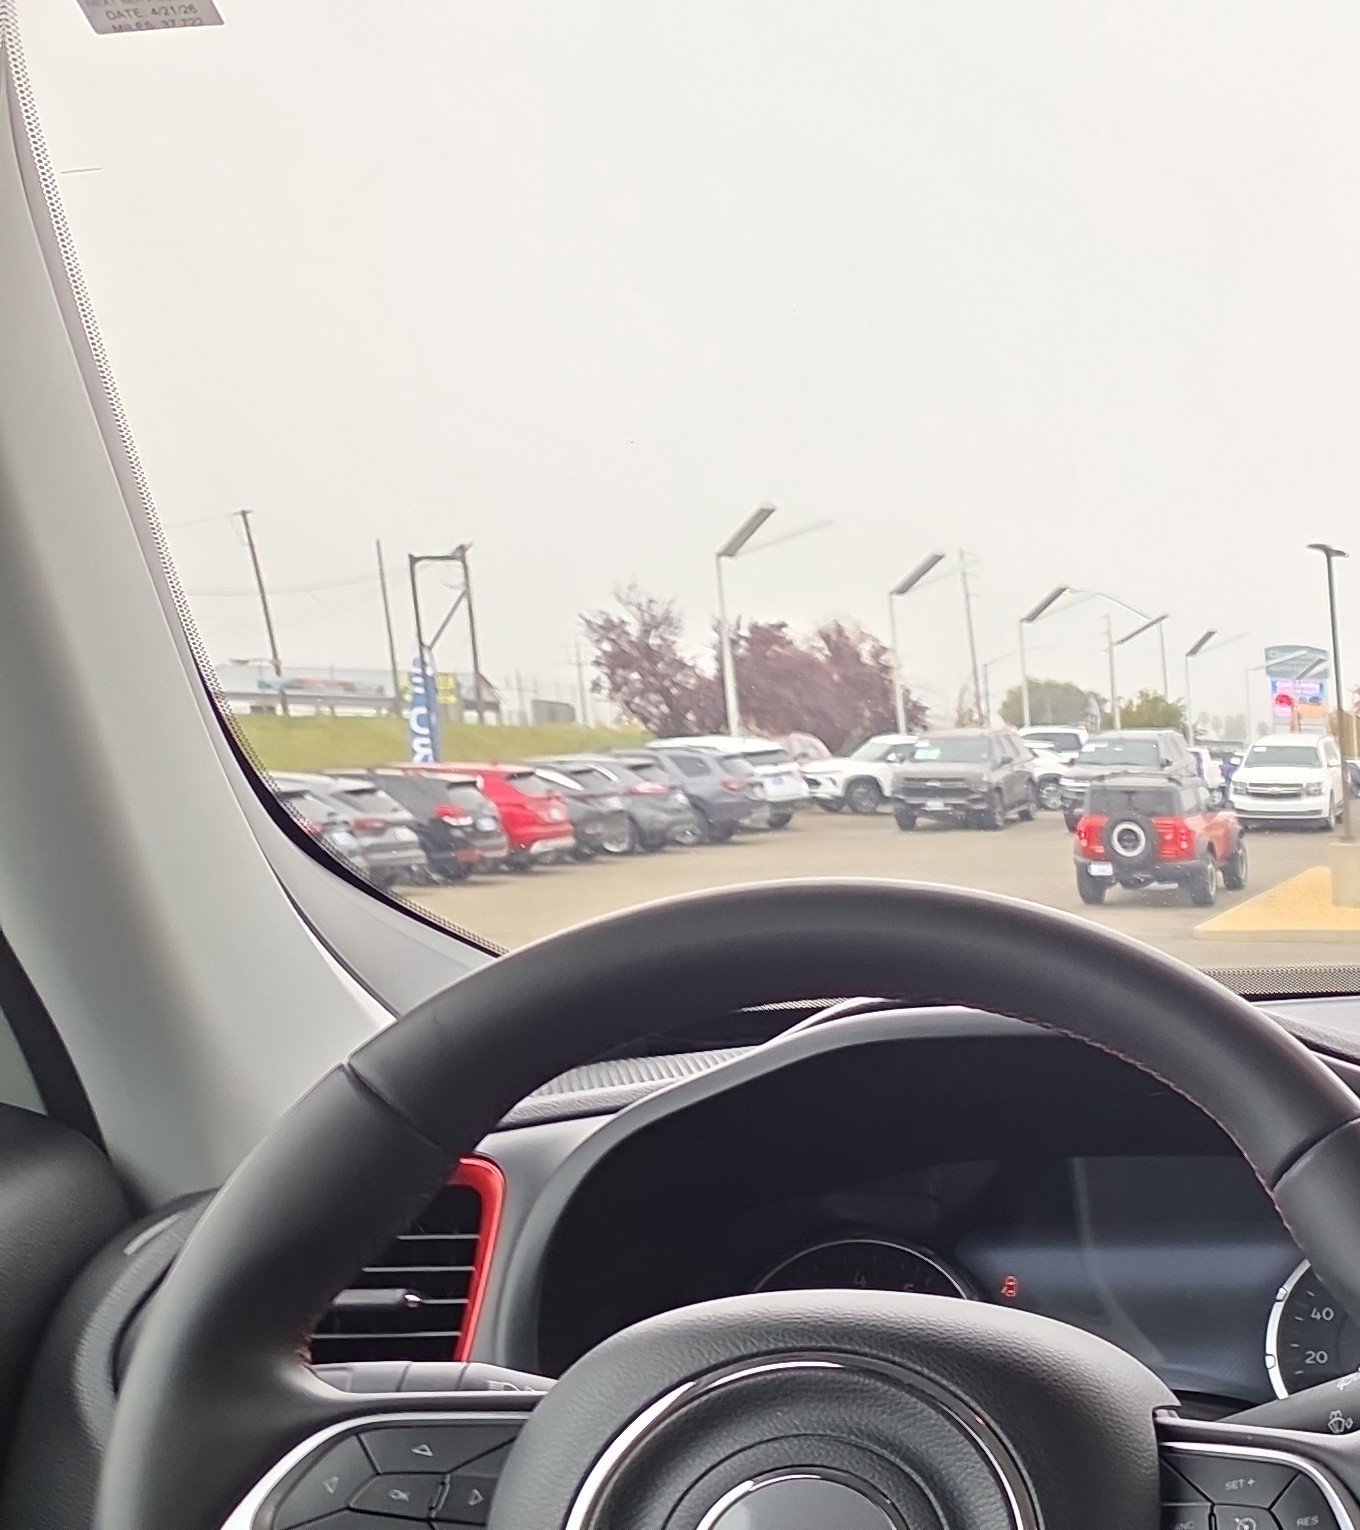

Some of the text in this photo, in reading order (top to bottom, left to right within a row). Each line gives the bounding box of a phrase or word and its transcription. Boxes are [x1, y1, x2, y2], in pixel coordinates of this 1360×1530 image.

[1310, 1307, 1335, 1322] 40
[1304, 1350, 1328, 1365] 20
[1296, 1514, 1320, 1527] RES
